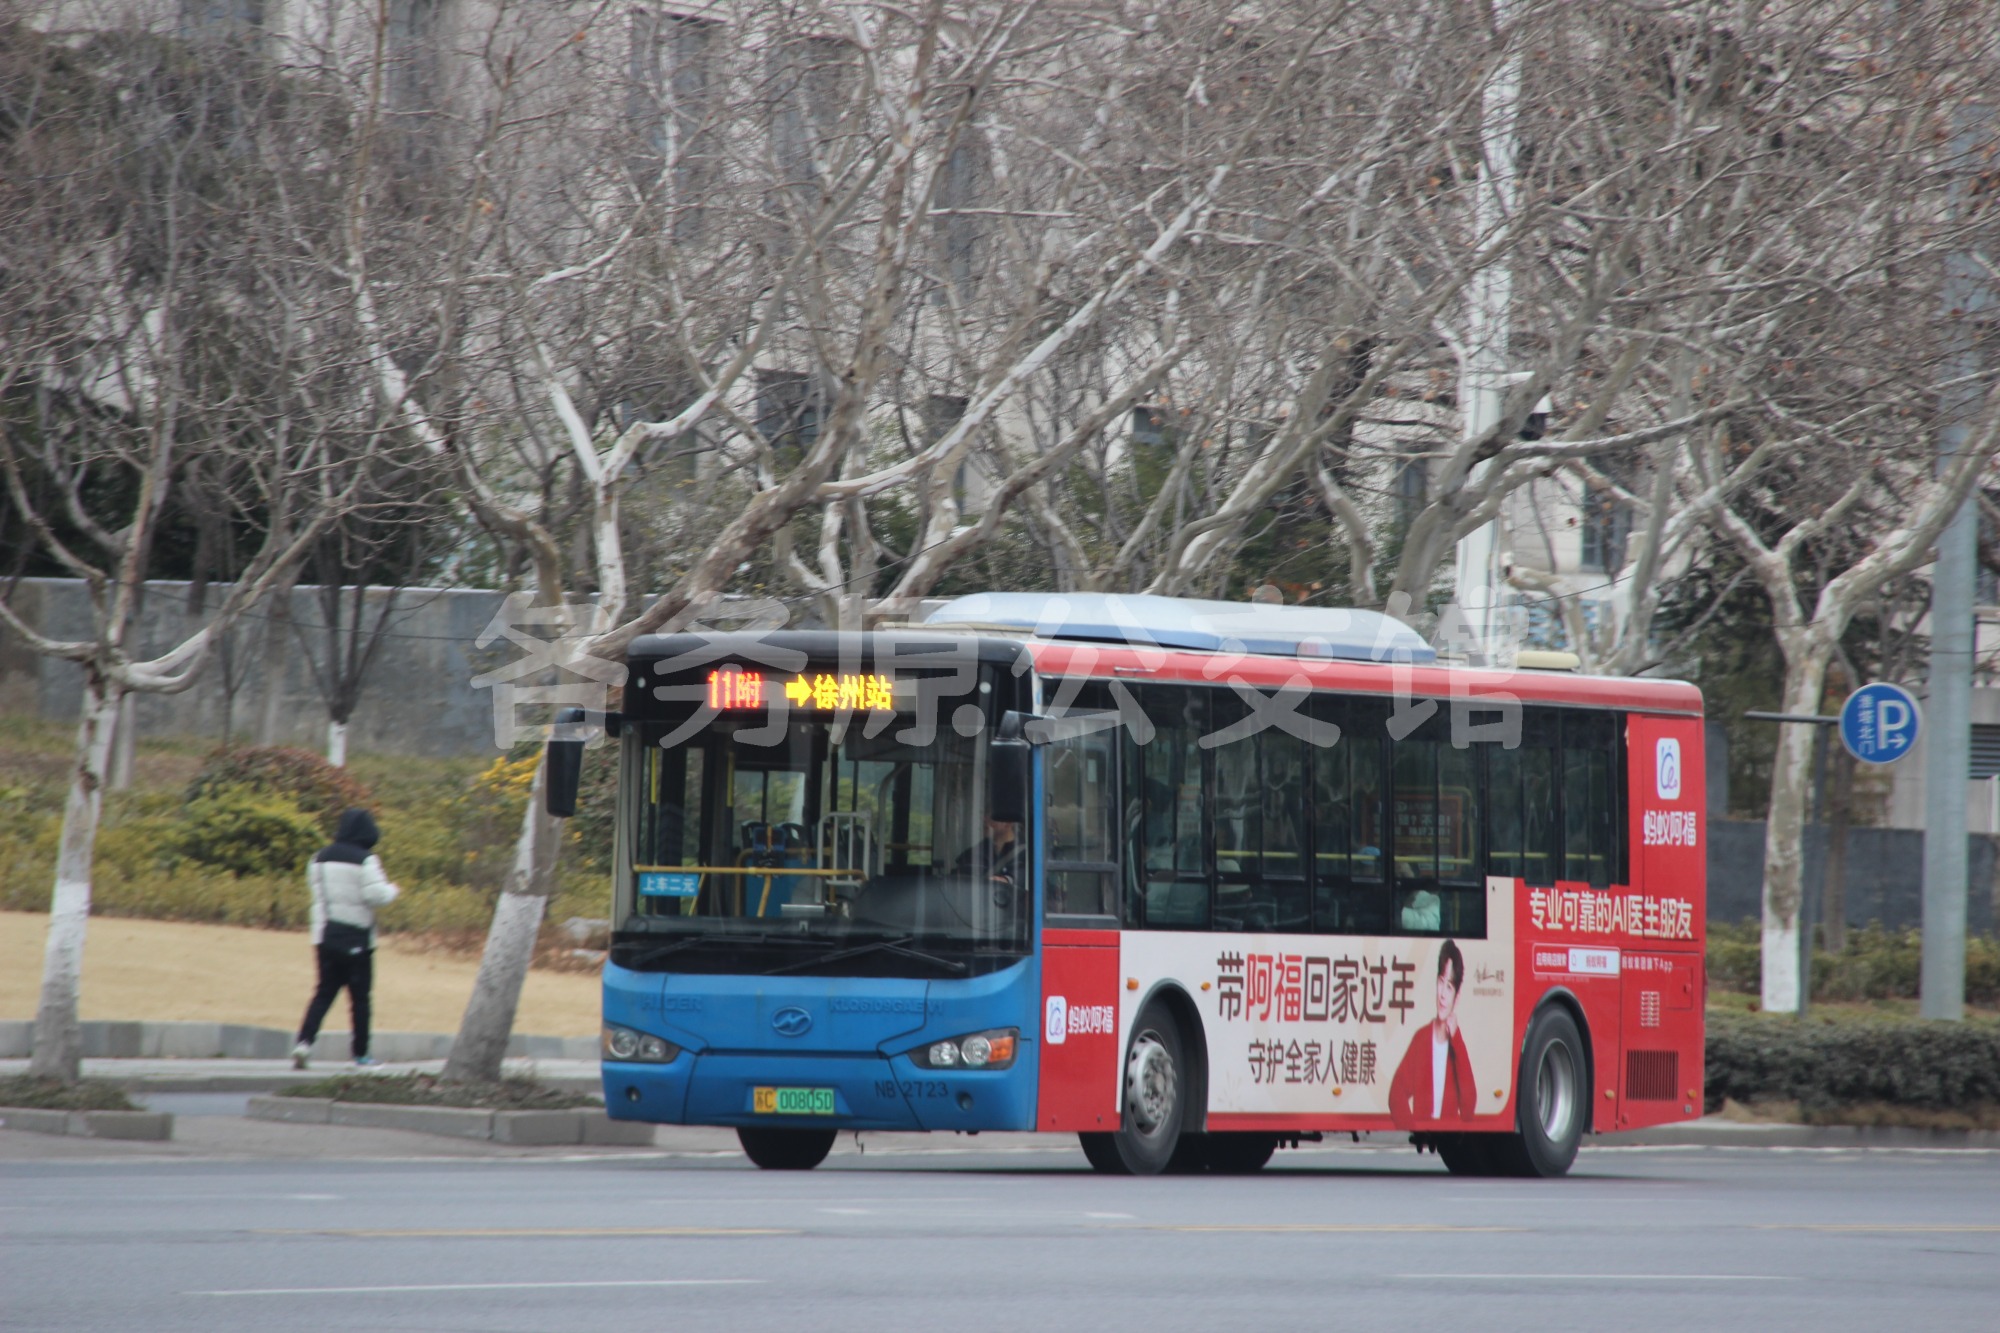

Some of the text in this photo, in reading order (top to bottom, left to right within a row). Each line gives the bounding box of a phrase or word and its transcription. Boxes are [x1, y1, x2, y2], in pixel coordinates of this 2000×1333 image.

[814, 674, 893, 710] 徐州站
[1878, 700, 1910, 749] P
[1643, 810, 1696, 846] 蚂蚁阿福
[642, 876, 695, 893] 上车二元
[1530, 888, 1692, 940] 专业可靠的AI医生朋友
[1217, 951, 1416, 1024] 带阿福回家过年
[1068, 1006, 1114, 1034] 蚂蚁阿福
[1248, 1038, 1377, 1085] 守护全家人健康
[902, 1082, 948, 1098] 2723
